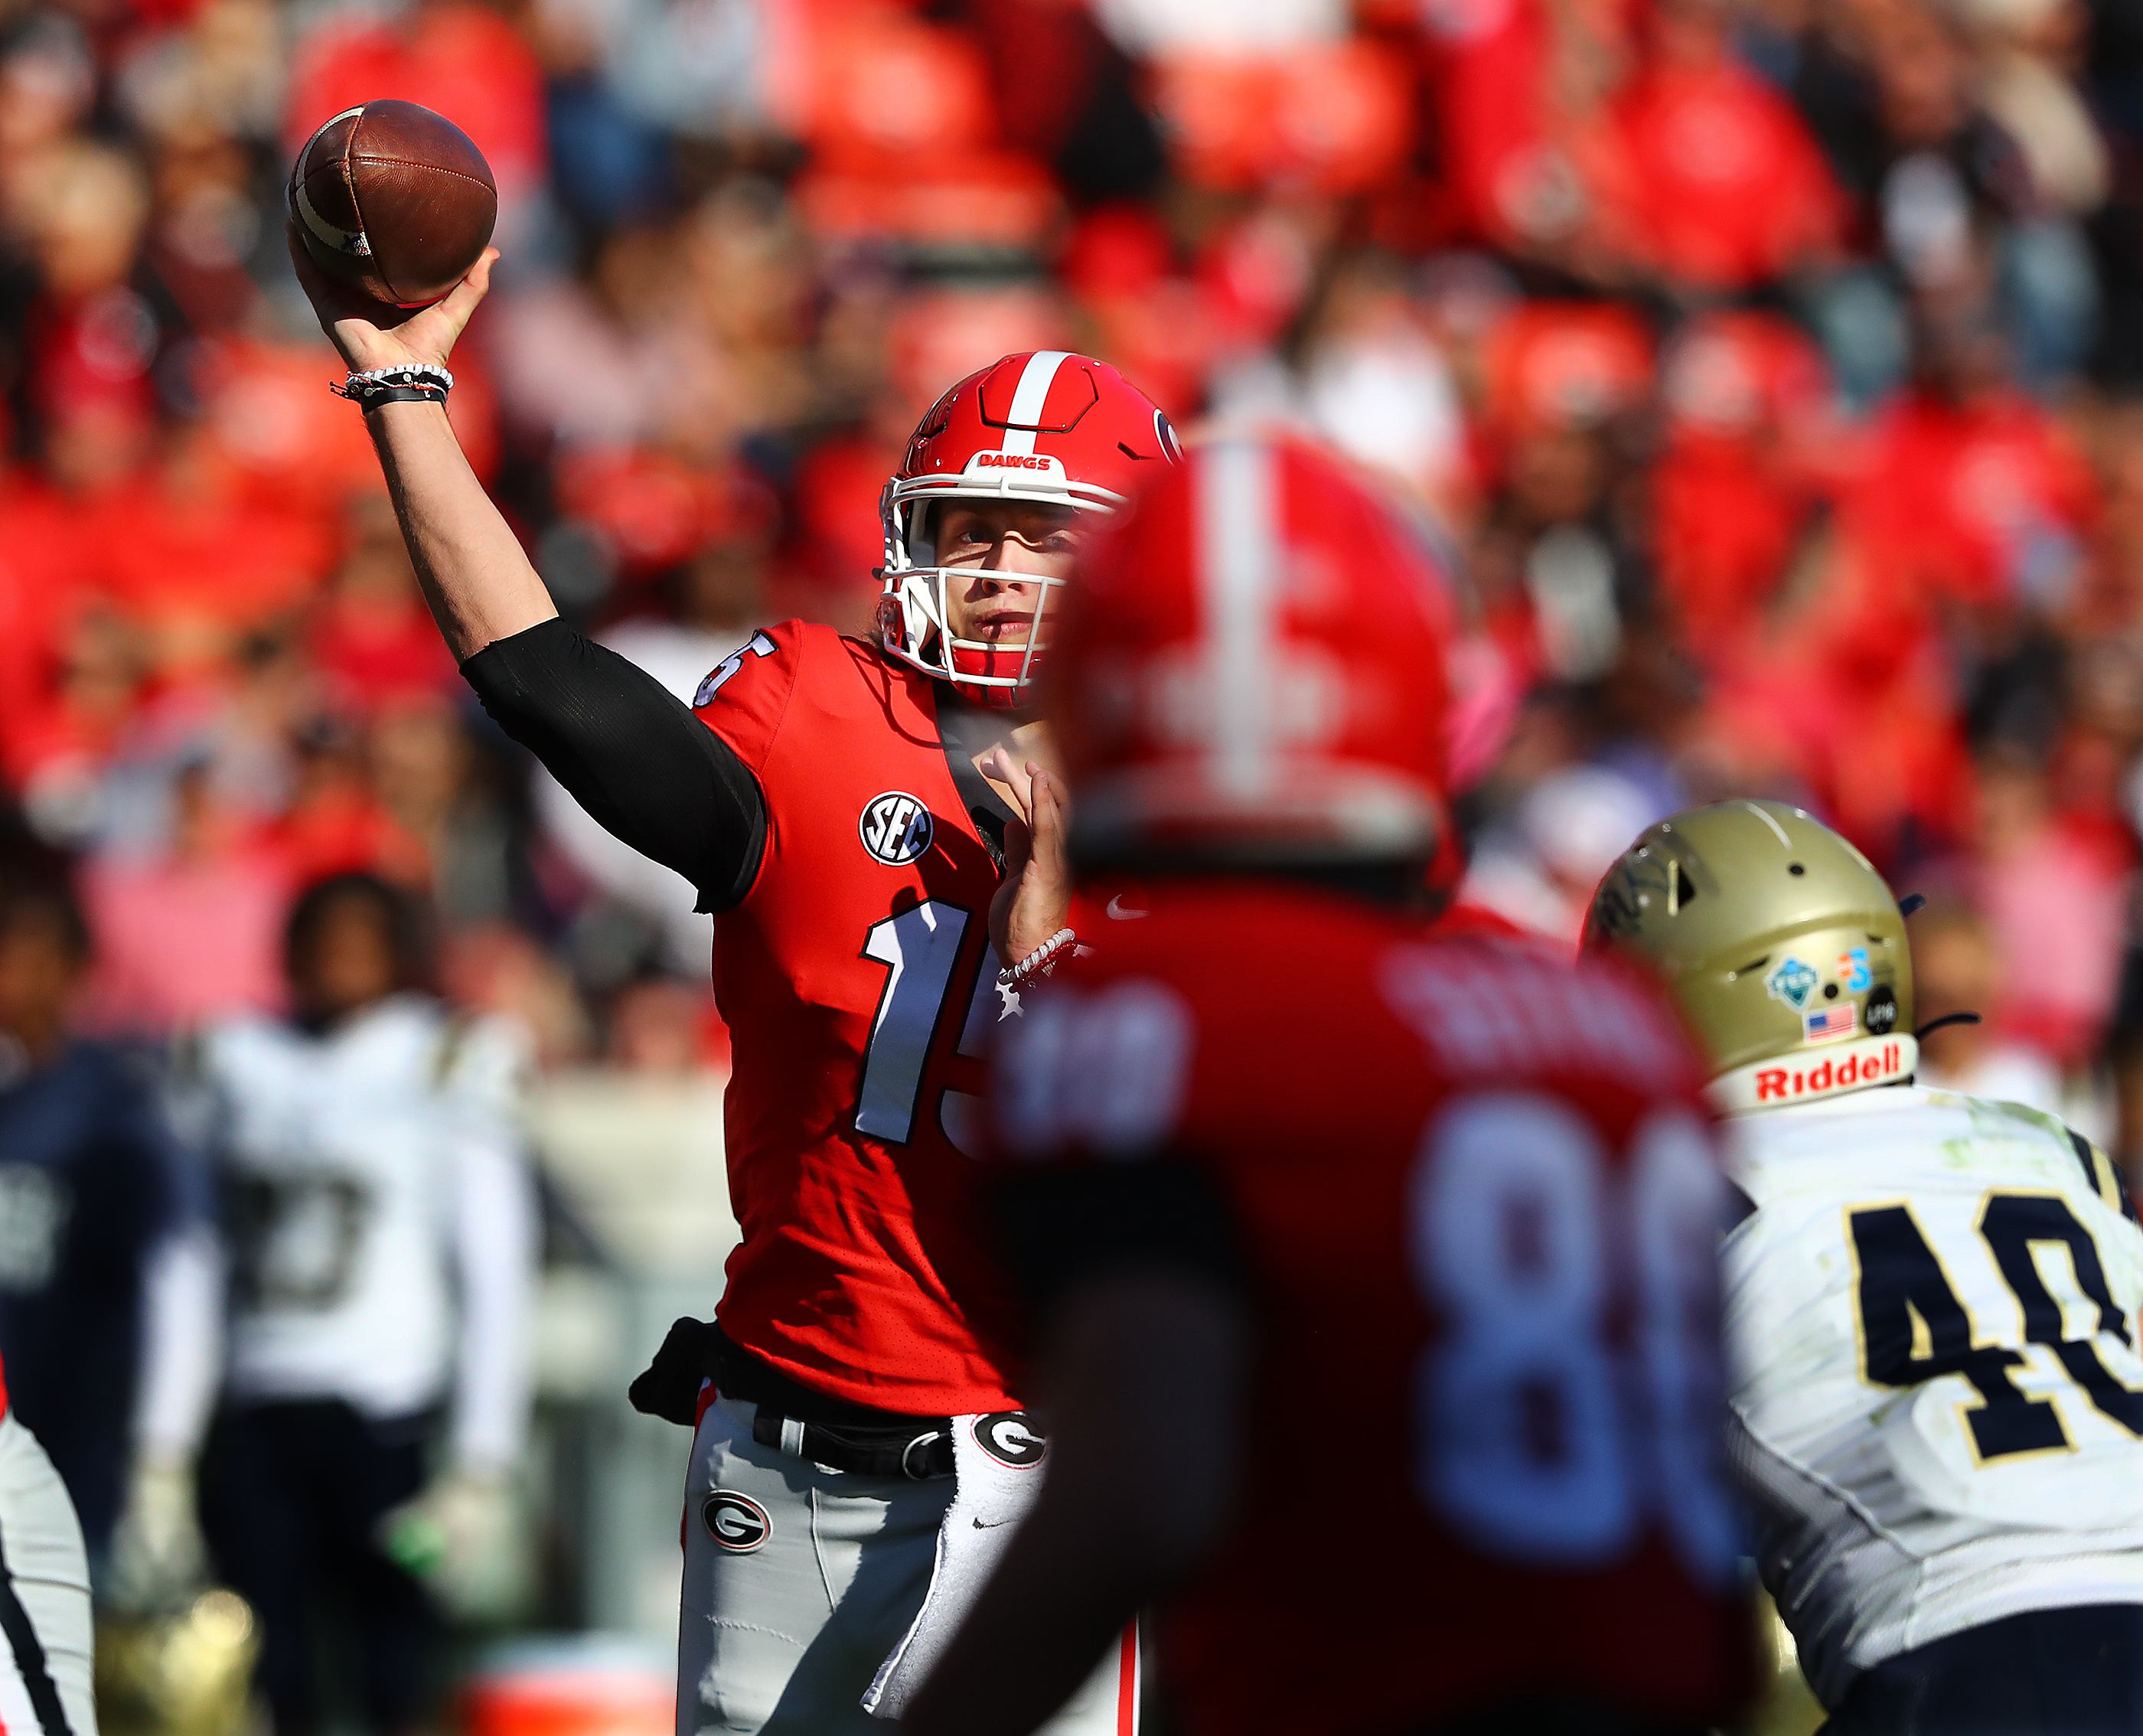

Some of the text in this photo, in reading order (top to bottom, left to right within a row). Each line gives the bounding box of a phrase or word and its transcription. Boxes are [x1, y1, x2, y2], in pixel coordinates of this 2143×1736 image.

[979, 454, 1051, 471] DAWGS
[865, 796, 927, 861] SEC
[1756, 1043, 1900, 1101] Riddell
[1841, 1186, 2143, 1470] 40
